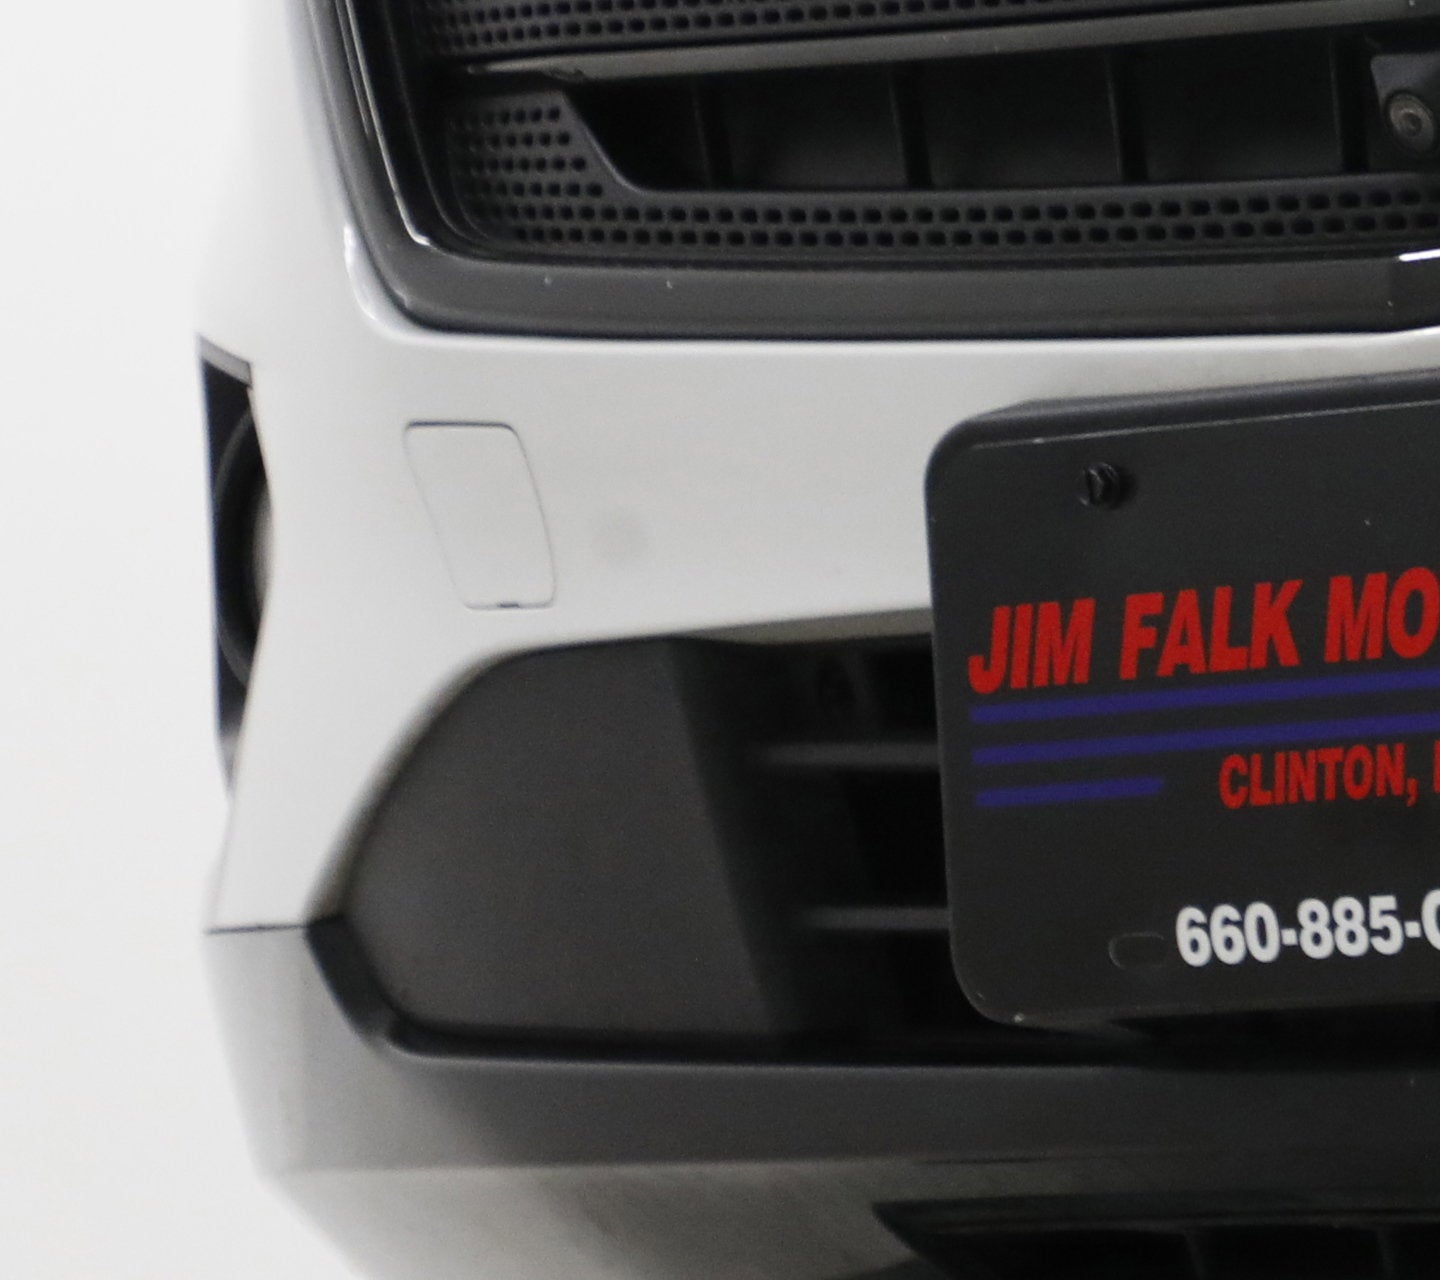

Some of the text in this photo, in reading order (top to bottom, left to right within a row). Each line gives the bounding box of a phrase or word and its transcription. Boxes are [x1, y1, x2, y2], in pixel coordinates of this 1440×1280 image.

[968, 598, 1095, 694] JIM
[1119, 579, 1303, 680] FALK
[1219, 743, 1418, 809] CLINTON,
